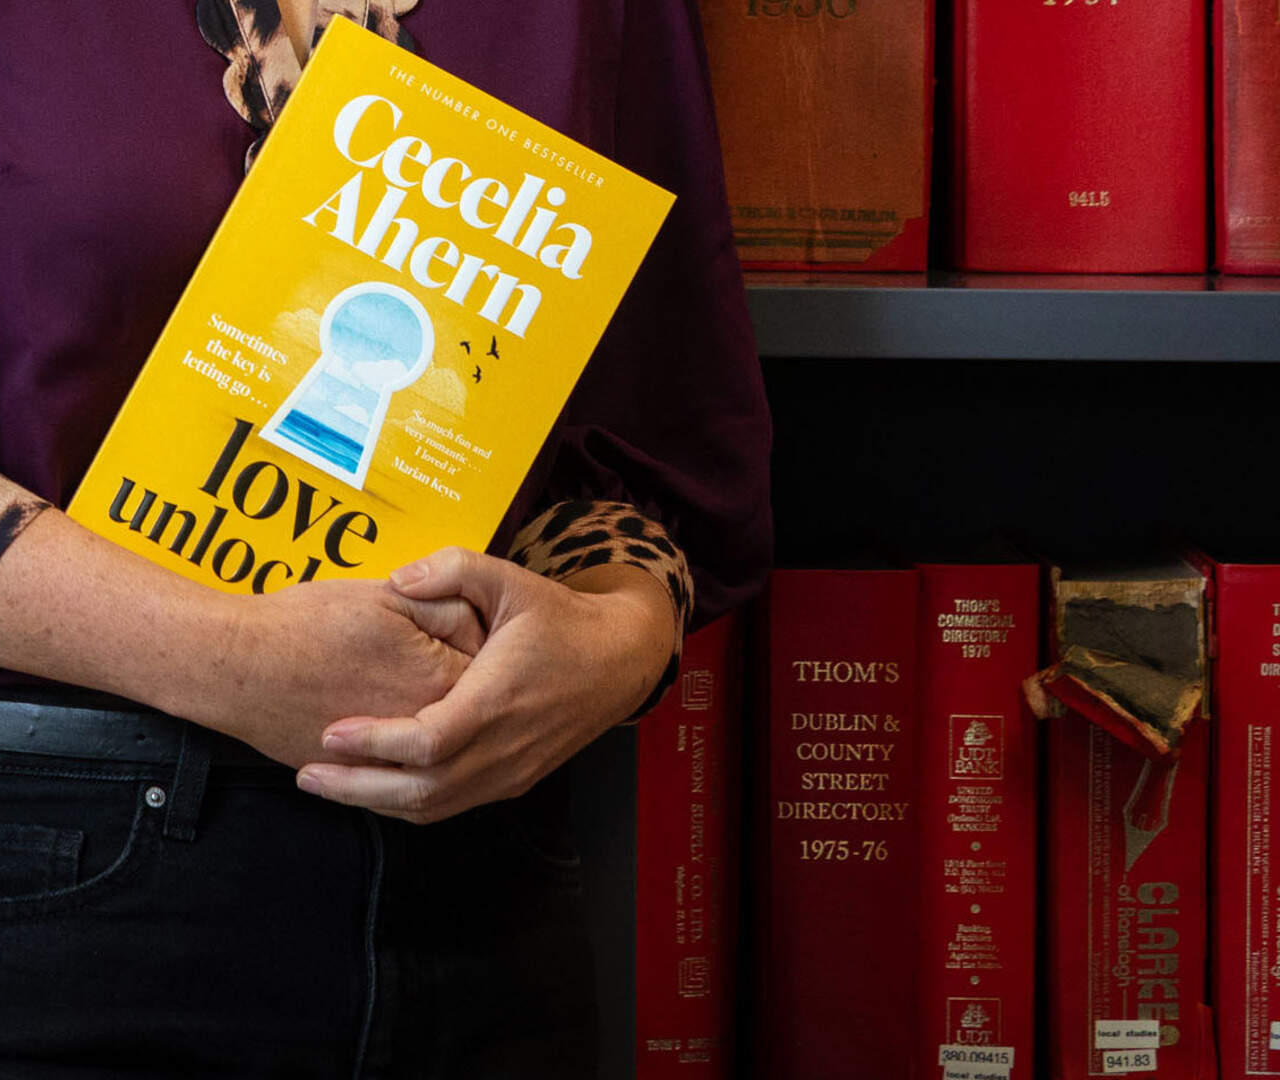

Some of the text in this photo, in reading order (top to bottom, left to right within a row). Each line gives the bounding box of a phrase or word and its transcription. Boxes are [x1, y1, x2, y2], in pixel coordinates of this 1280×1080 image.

[389, 65, 605, 188] THE NUMBER ONE BESTSELLER
[333, 94, 594, 279] Cecelia
[1069, 191, 1110, 206] 941.5
[302, 170, 542, 338] Ahern
[208, 313, 287, 365] Sometimes
[183, 350, 230, 389] letting
[206, 339, 271, 382] the key is
[198, 417, 378, 568] love
[954, 599, 1000, 614] THOM'S
[938, 614, 1015, 629] COMMERCIAL
[943, 629, 1007, 644] DIRECTORY
[962, 645, 991, 659] 1976
[793, 661, 901, 685] THOM'S
[791, 713, 900, 732] DUBLIN &
[796, 743, 894, 762] COUNTY
[958, 747, 994, 762] UDT
[955, 760, 1001, 775] BANK
[801, 772, 889, 792] STREET
[691, 726, 704, 864] LAWSON SUPPLY
[777, 802, 909, 821] DIRECTORY
[799, 840, 889, 861] 1975-76
[956, 1030, 992, 1044] UDT
[1107, 1056, 1150, 1068] 941.83
[946, 1071, 1007, 1080] local studies
